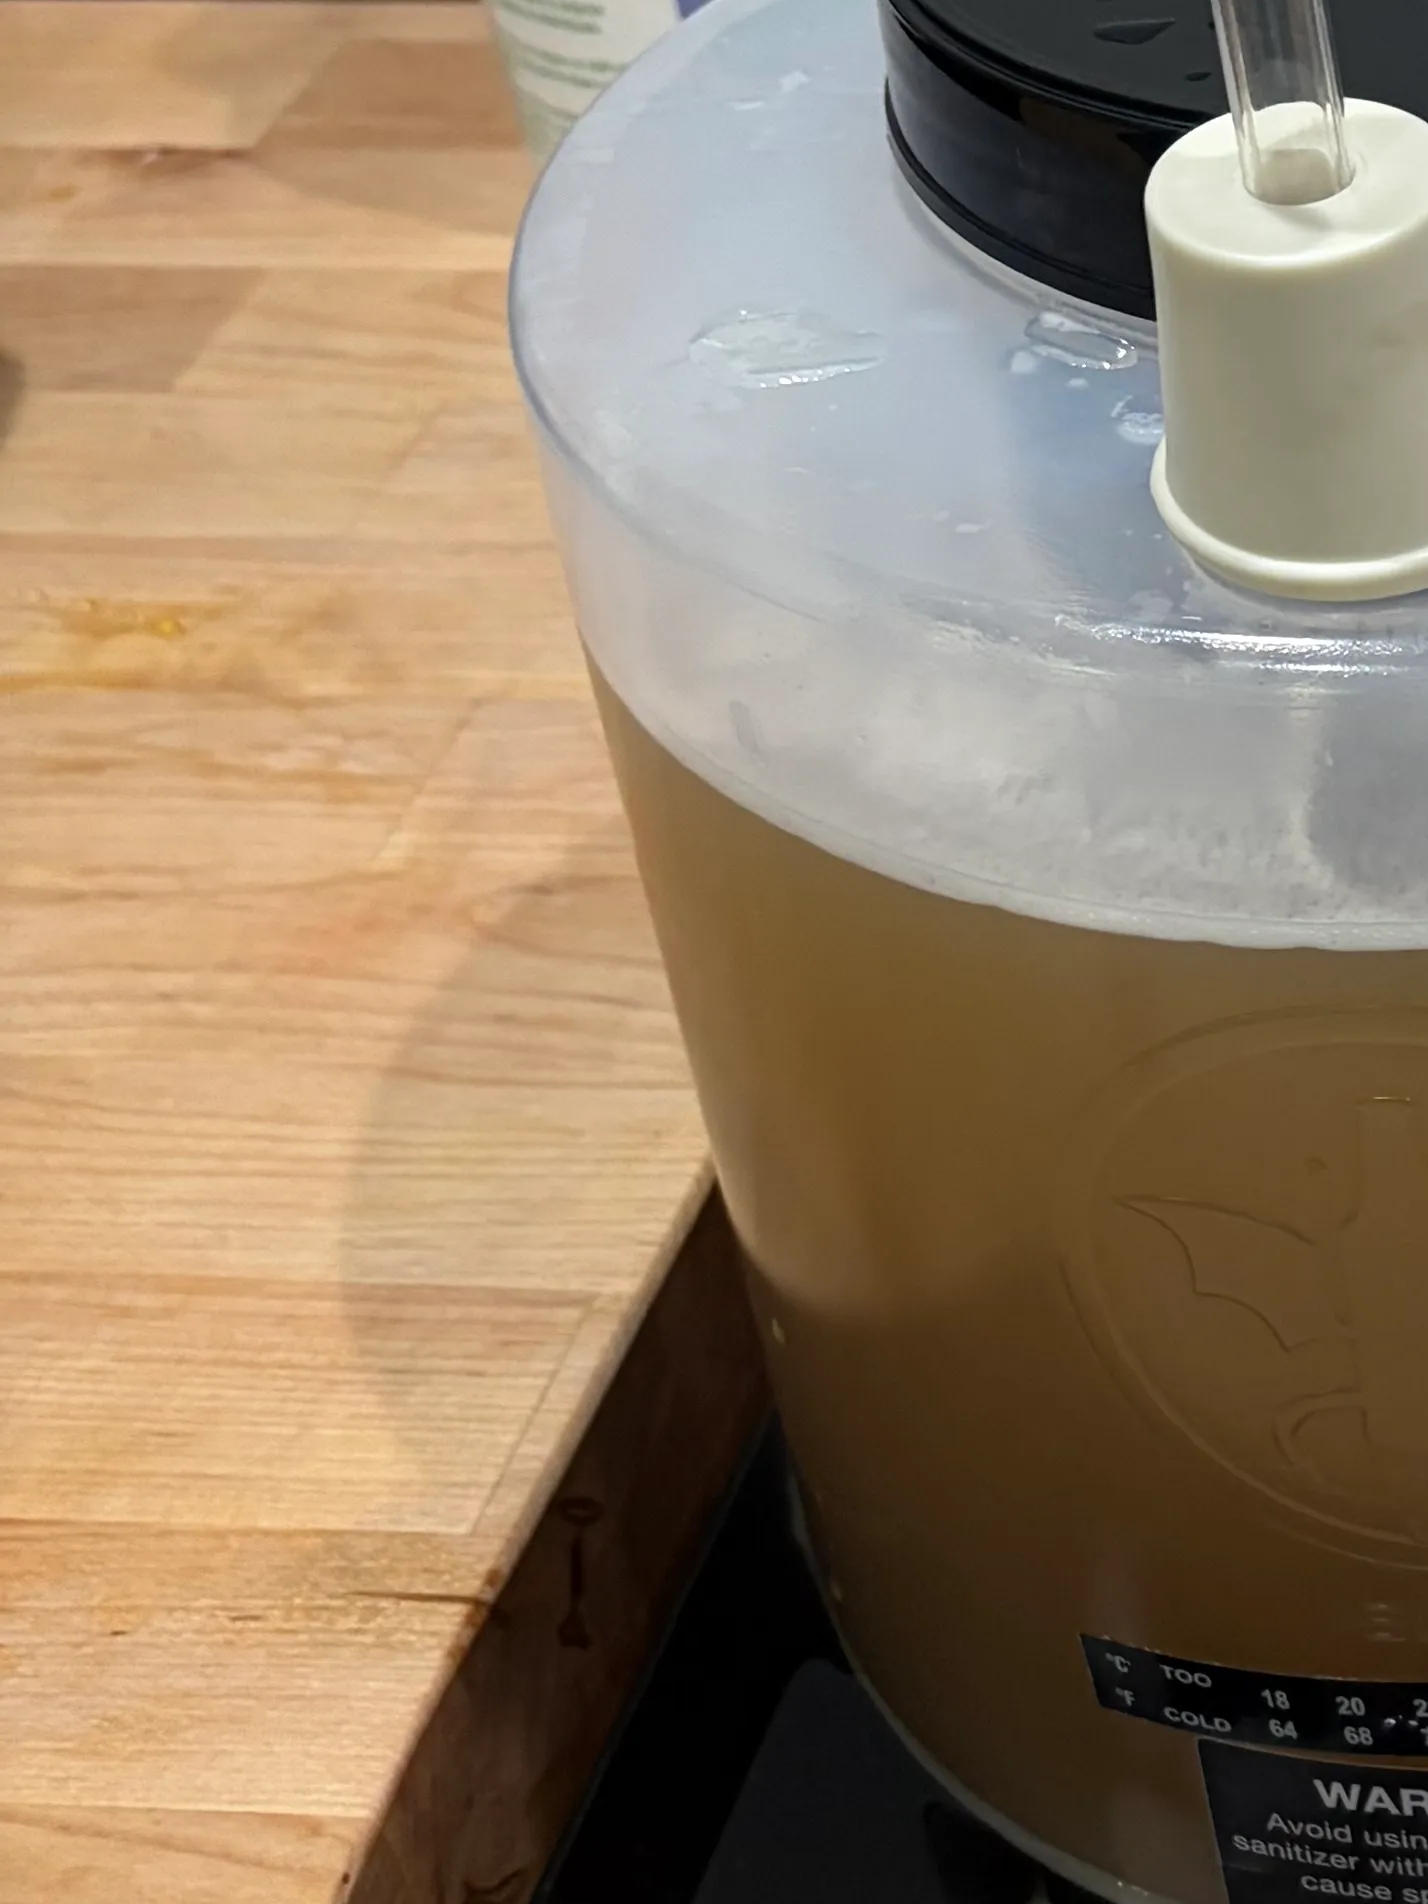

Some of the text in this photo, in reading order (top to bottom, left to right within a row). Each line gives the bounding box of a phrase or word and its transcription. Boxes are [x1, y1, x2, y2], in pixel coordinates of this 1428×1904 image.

[1158, 1663, 1212, 1689] TOO
[1261, 1688, 1290, 1711] 18
[1335, 1696, 1366, 1717] 20
[1163, 1706, 1232, 1733] COLD
[1268, 1718, 1298, 1740] 64
[1343, 1725, 1374, 1746] 68
[1267, 1812, 1353, 1843] Avoid
[1231, 1834, 1360, 1871] sanitizer
[1300, 1874, 1393, 1901] cause
